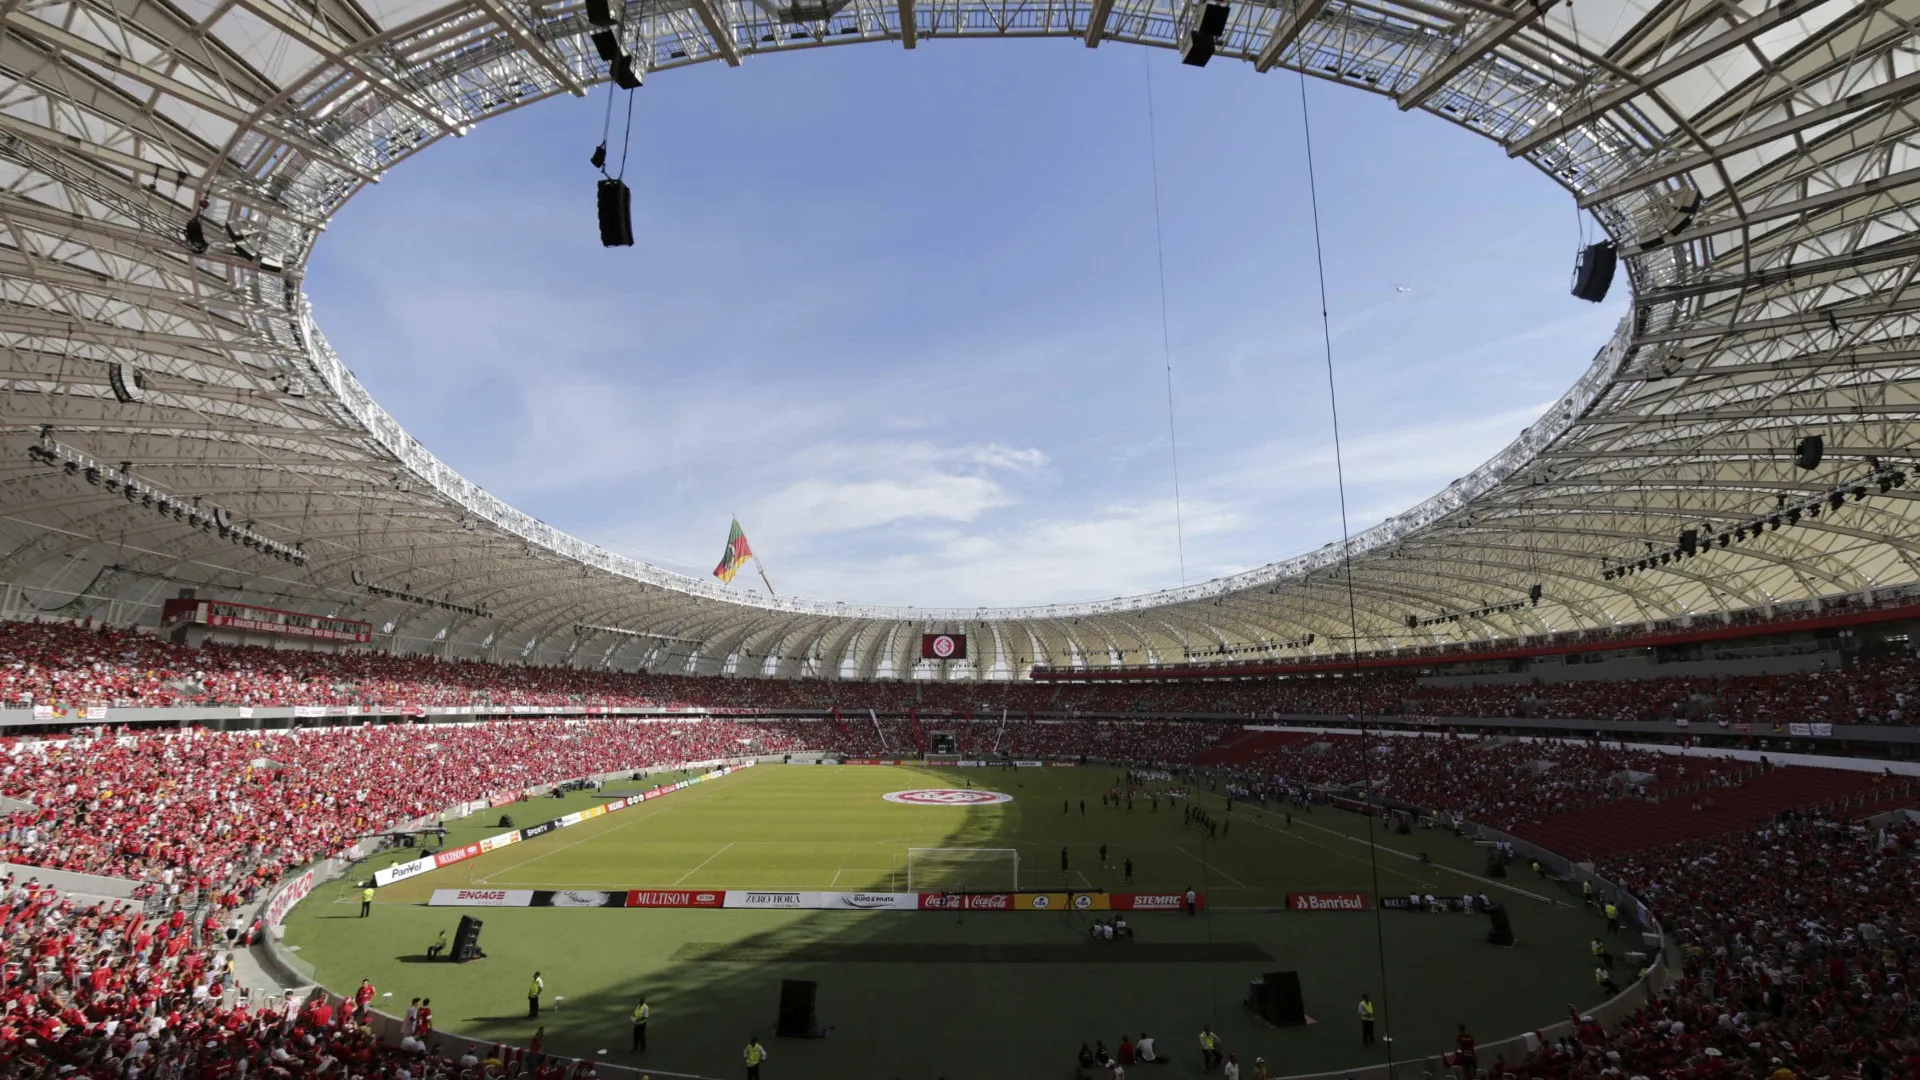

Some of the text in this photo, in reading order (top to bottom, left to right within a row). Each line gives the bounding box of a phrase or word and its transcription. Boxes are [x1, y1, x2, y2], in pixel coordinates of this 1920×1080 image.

[233, 619, 255, 629] MAIOR
[261, 622, 287, 633] MELHOR
[287, 625, 313, 636] TORCIDA
[314, 628, 323, 637] DO
[323, 630, 334, 638] RIO
[334, 631, 357, 640] GRANDE
[457, 890, 506, 900] ENGAGE
[636, 892, 690, 905] MULTISOM
[745, 894, 800, 904] ZERO HORA
[1133, 895, 1182, 905] STEMAC
[1308, 894, 1363, 909] Banrisul
